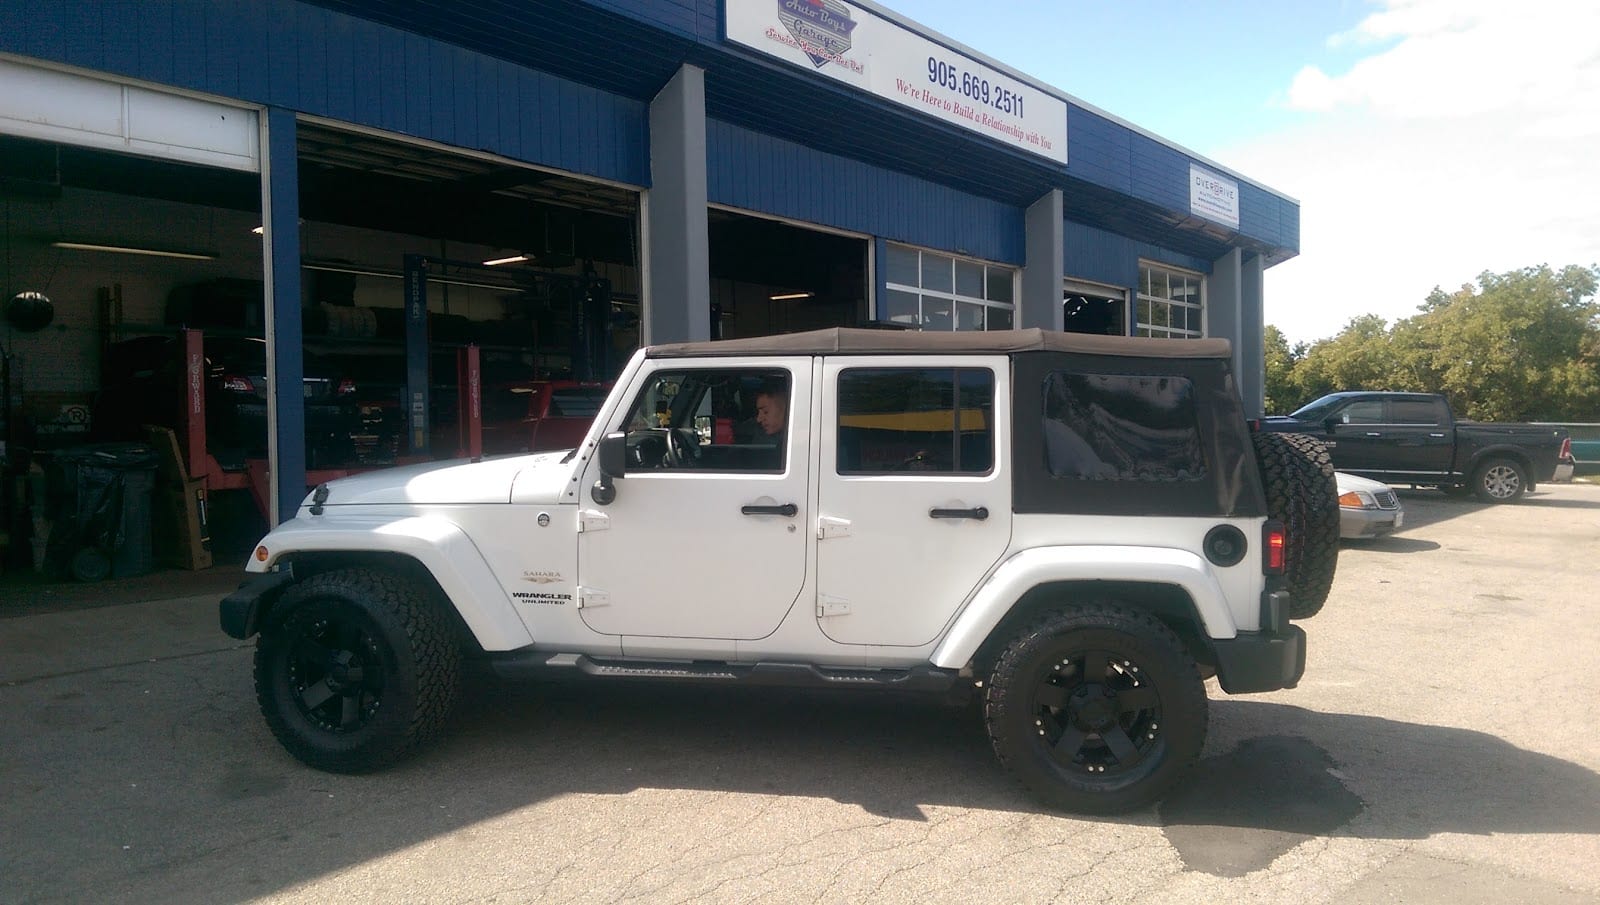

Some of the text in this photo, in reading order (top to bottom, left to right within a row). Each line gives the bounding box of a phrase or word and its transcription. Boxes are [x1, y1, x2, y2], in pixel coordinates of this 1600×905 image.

[786, 0, 847, 32] Auto Boys
[765, 28, 798, 47] Service
[800, 40, 818, 56] You
[818, 48, 835, 61] Can
[794, 19, 840, 47] Garage
[928, 56, 1024, 119] 905.669.2511
[896, 78, 1053, 150] We're Here to Build a Relationship with You
[512, 592, 572, 600] WRANGLER
